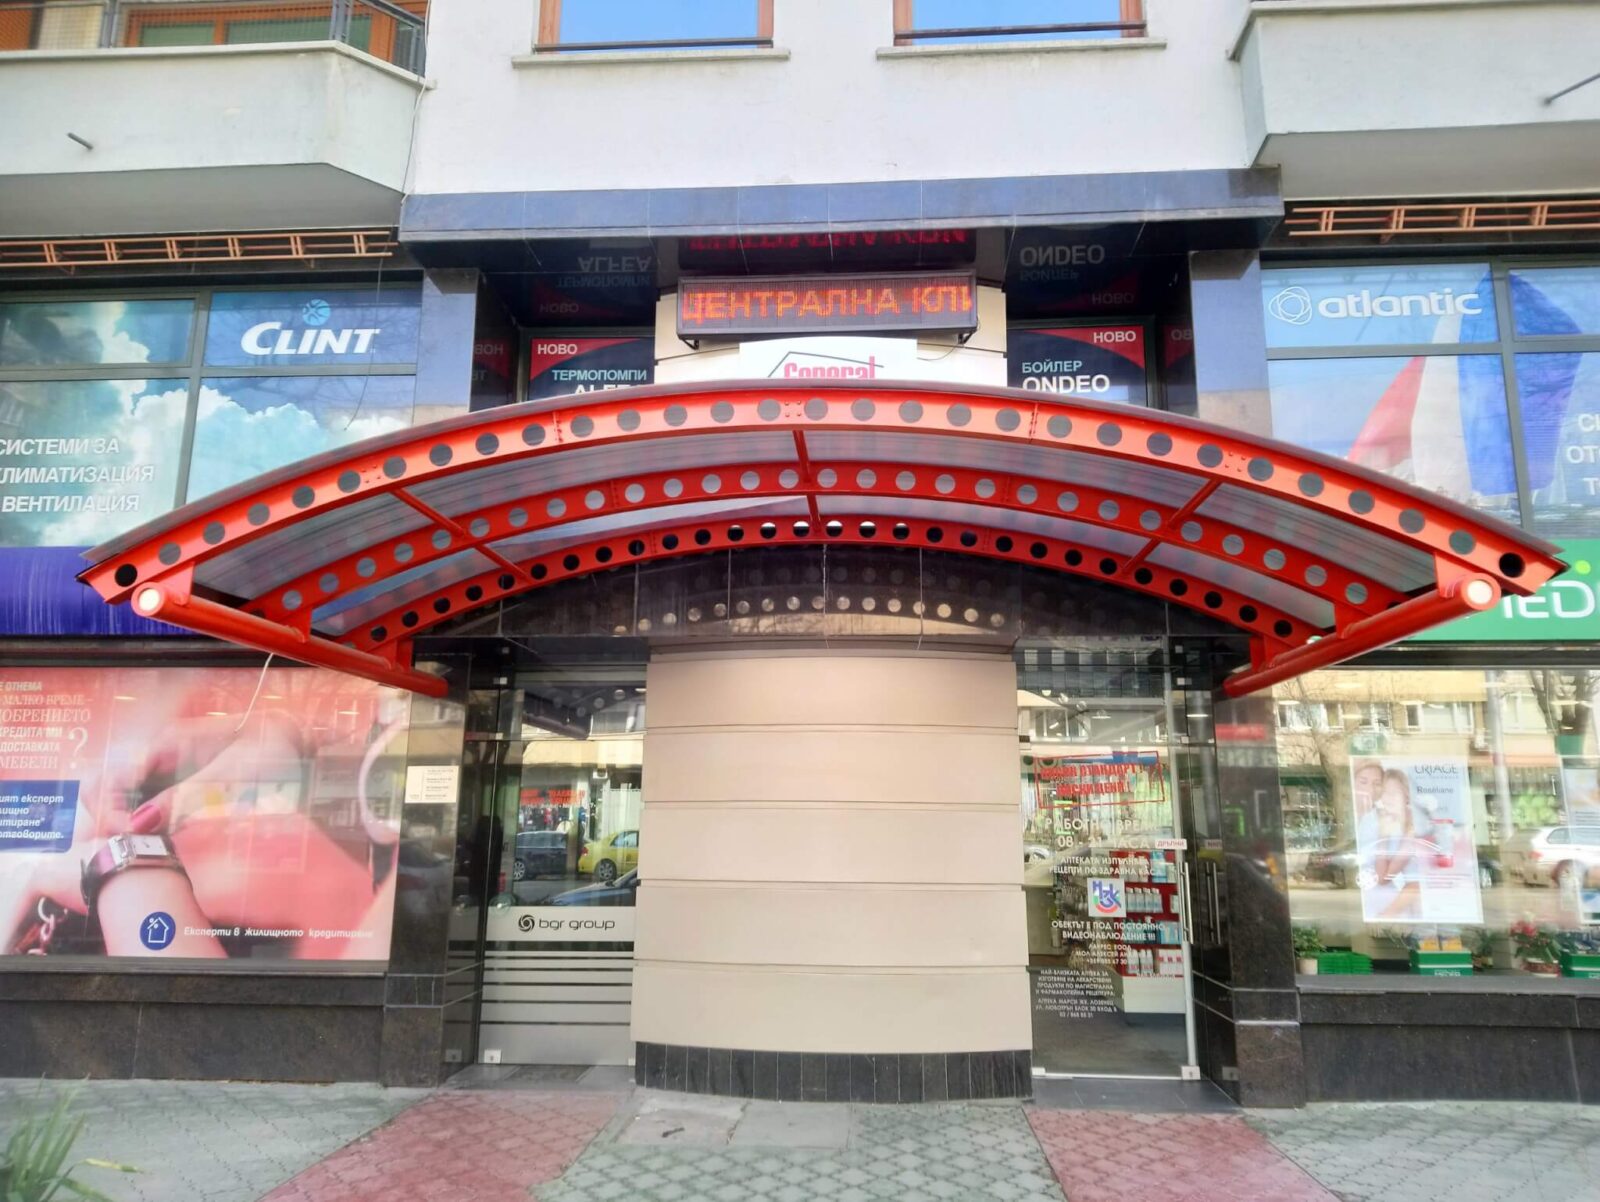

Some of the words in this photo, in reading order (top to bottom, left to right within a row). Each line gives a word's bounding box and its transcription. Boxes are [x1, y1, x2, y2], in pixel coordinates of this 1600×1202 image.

[682, 287, 901, 324] ЦЕНТРАЛНА
[912, 285, 972, 314] КЛ
[1318, 288, 1483, 318] atlantic
[241, 321, 382, 355] CLINT
[1093, 331, 1137, 343] НОВО
[537, 343, 578, 355] НОВО
[1022, 360, 1082, 374] БОЙЛЕР
[552, 369, 647, 381] ТЕРМОПОМПИ
[1023, 374, 1110, 394] ONDEO
[94, 438, 120, 454] ЗА
[1566, 445, 1600, 463] ОТ
[2, 495, 140, 513] ВЕНТИЛАЦИЯ
[0, 708, 91, 723] ОБРЕНИЕТО
[21, 794, 64, 805] експерт
[1057, 836, 1074, 848] 08
[539, 919, 565, 930] bgr
[569, 920, 615, 930] group
[1051, 920, 1085, 929] ОБЕКТЪТ
[1093, 921, 1112, 930] ПОД
[184, 926, 232, 938] Експерти
[244, 928, 304, 939] жилищното
